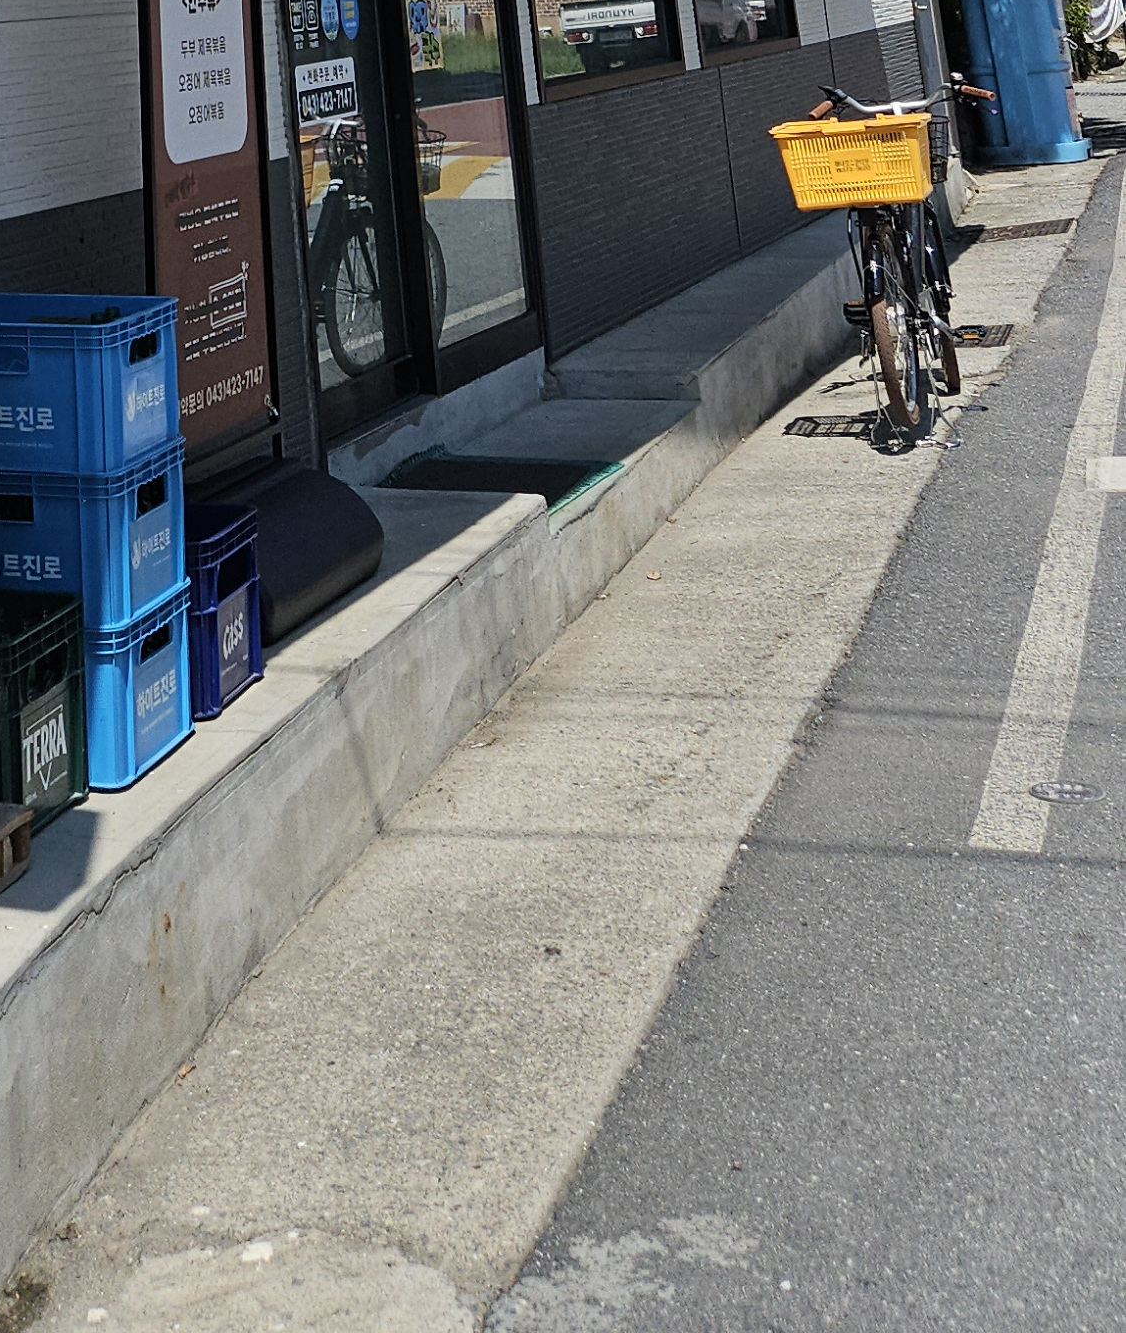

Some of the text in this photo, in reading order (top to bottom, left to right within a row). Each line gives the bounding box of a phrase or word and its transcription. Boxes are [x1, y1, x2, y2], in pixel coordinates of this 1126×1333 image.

[181, 35, 226, 59] 두부 제육볶음
[178, 67, 231, 92] 오징어 제육볶음
[188, 101, 225, 125] 오징어볶음
[178, 389, 205, 420] 약문의
[136, 668, 177, 718] 하이트진로
[23, 712, 68, 784] TERRA
